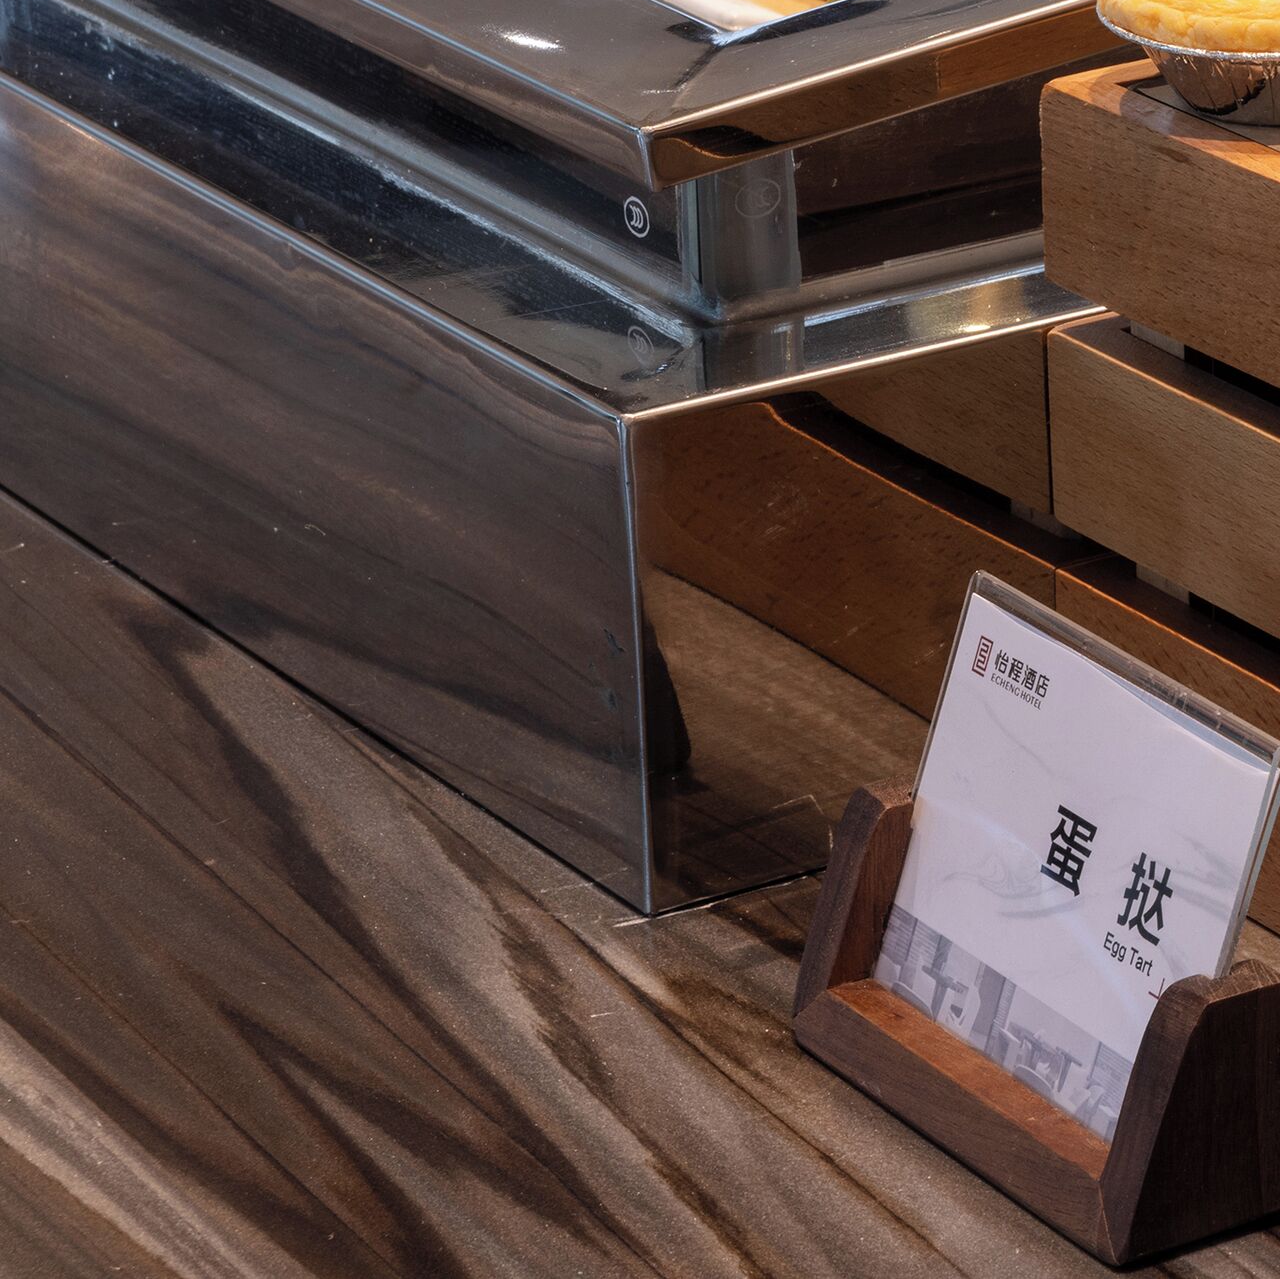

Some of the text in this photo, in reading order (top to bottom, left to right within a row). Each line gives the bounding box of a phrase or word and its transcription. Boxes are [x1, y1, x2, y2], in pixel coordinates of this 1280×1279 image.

[990, 673, 1042, 710] ECHENG HOTEL
[994, 649, 1050, 698] 怡程酒店
[1103, 932, 1153, 977] Egg Tart
